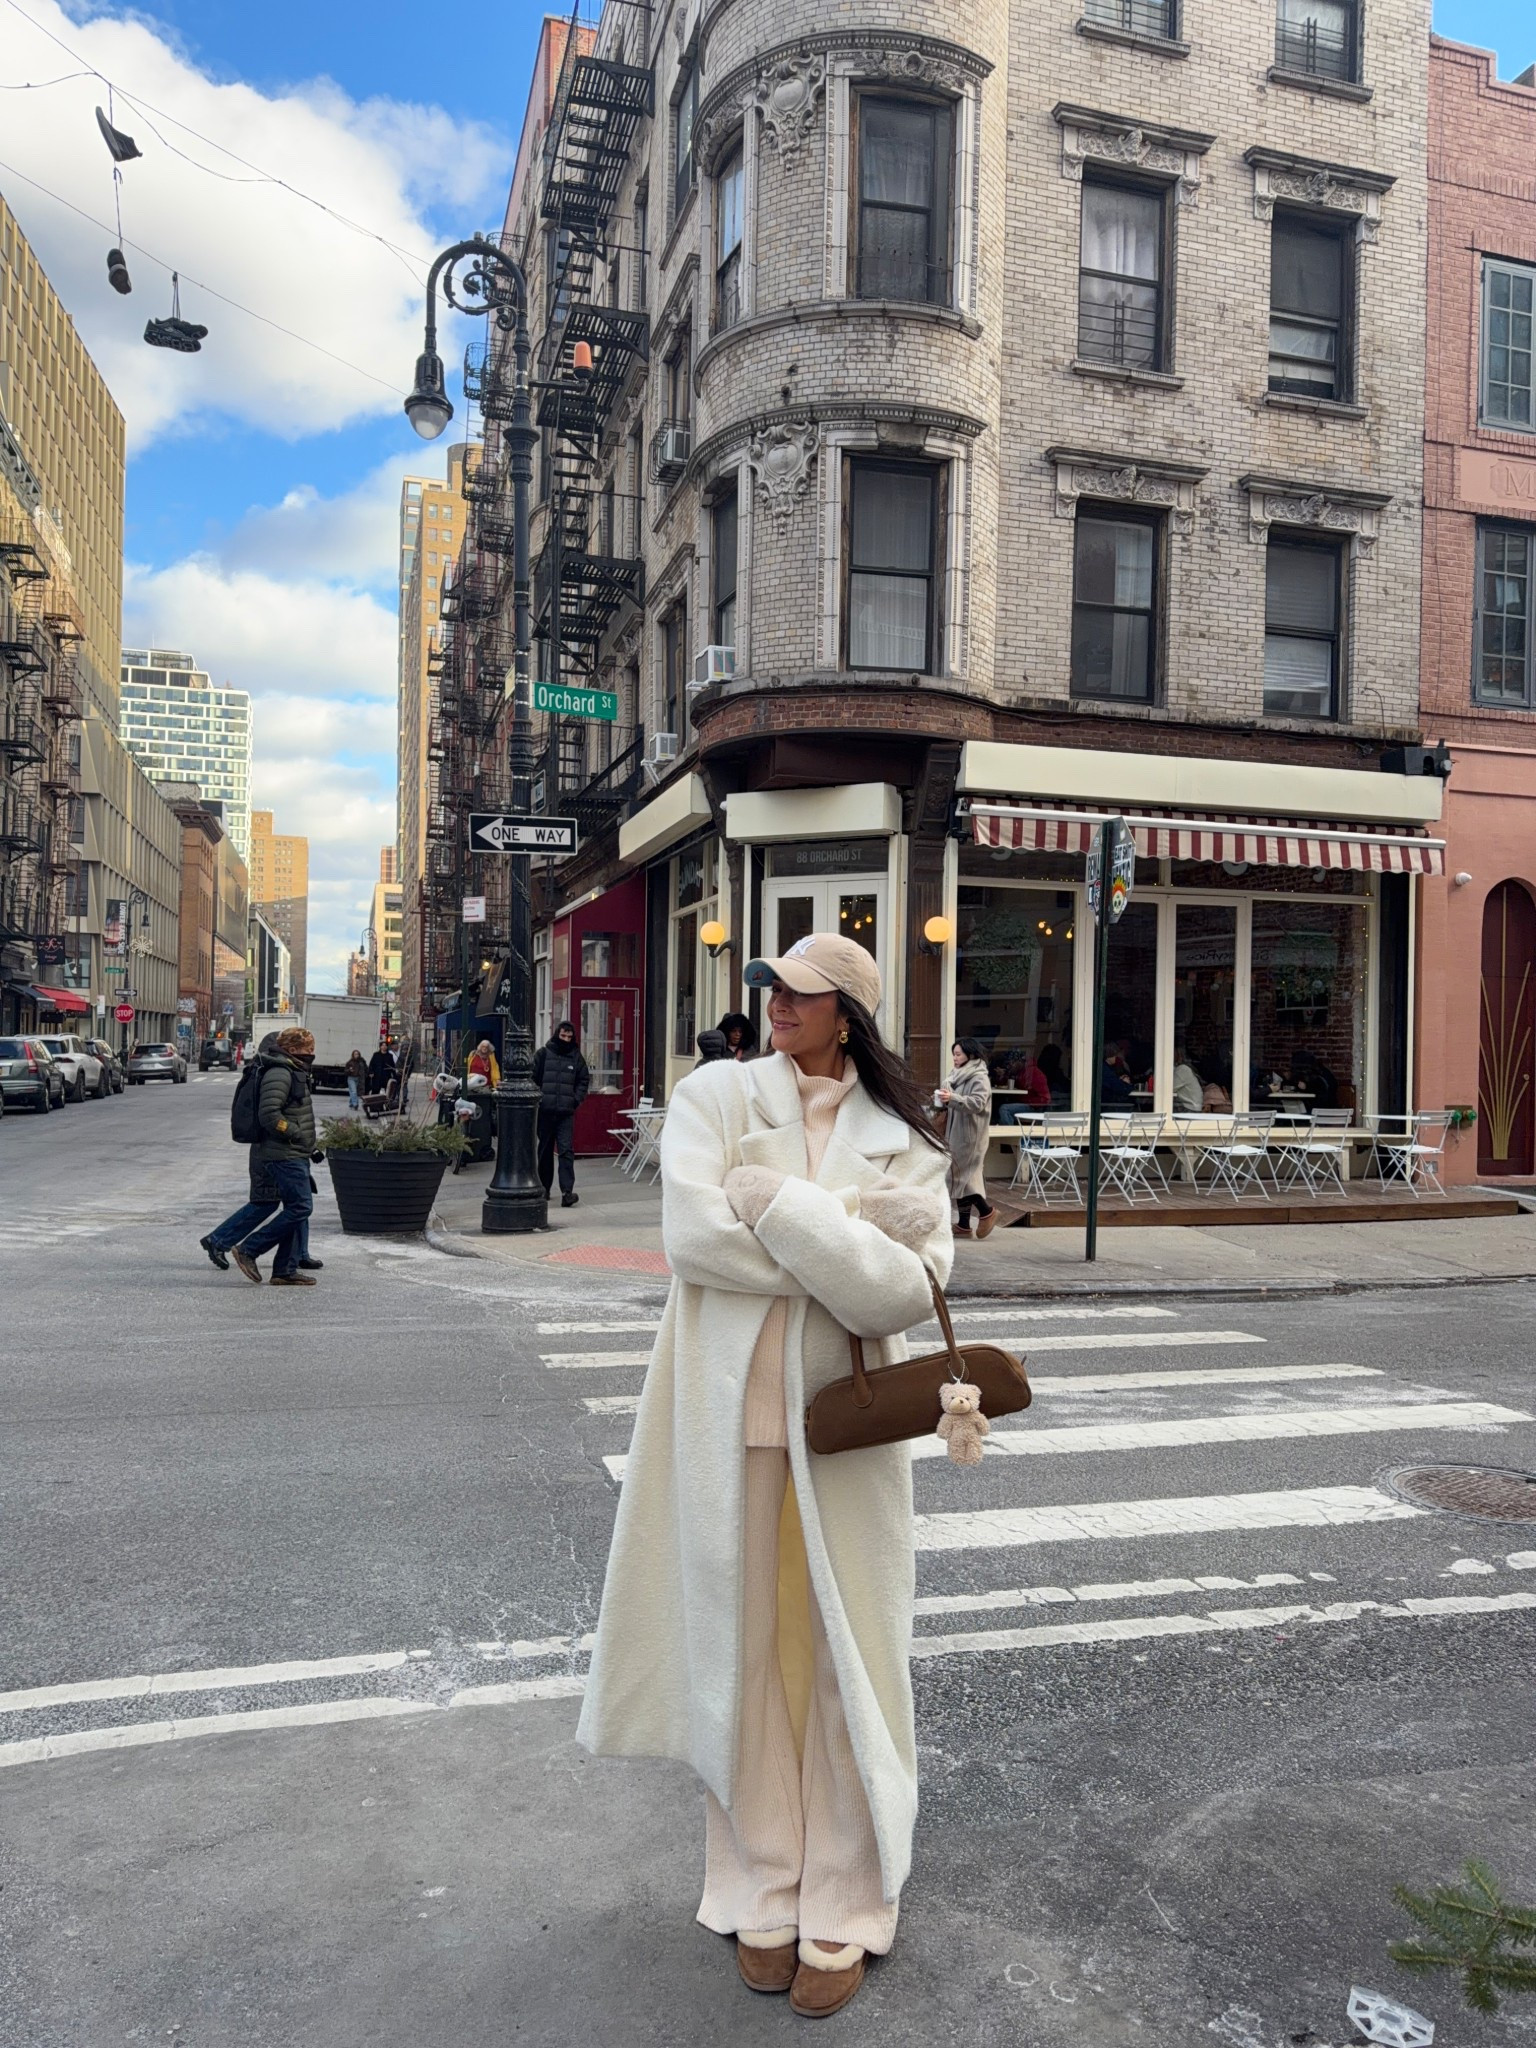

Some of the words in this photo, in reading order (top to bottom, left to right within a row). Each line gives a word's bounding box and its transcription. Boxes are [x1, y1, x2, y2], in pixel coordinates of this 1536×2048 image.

[538, 686, 595, 714] Orchard
[601, 695, 612, 709] St
[491, 826, 521, 841] ONE
[535, 828, 565, 843] WAY
[796, 850, 808, 864] 88
[810, 848, 850, 863] ORCHARD
[851, 848, 862, 861] ST
[116, 1009, 133, 1018] STOP
